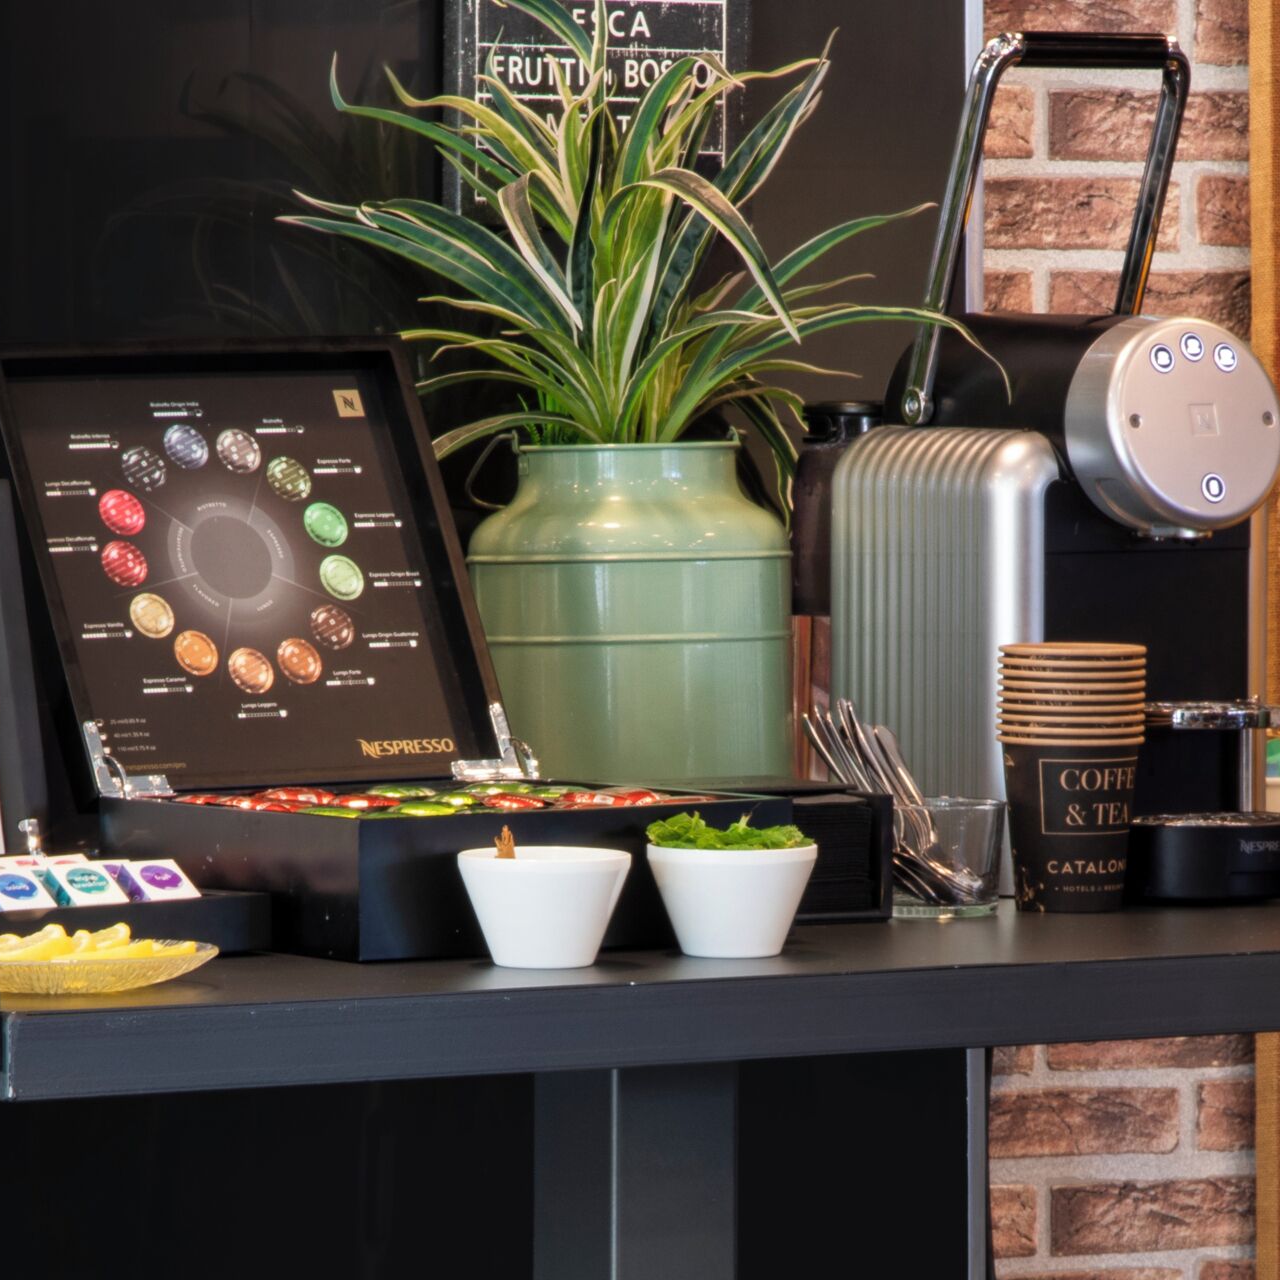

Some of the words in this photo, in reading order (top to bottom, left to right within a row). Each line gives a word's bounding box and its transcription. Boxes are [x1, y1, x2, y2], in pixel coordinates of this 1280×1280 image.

[625, 59, 710, 88] BOSO
[356, 738, 454, 759] NESPRESSO
[1065, 803, 1087, 826] &
[1093, 801, 1129, 825] TEA
